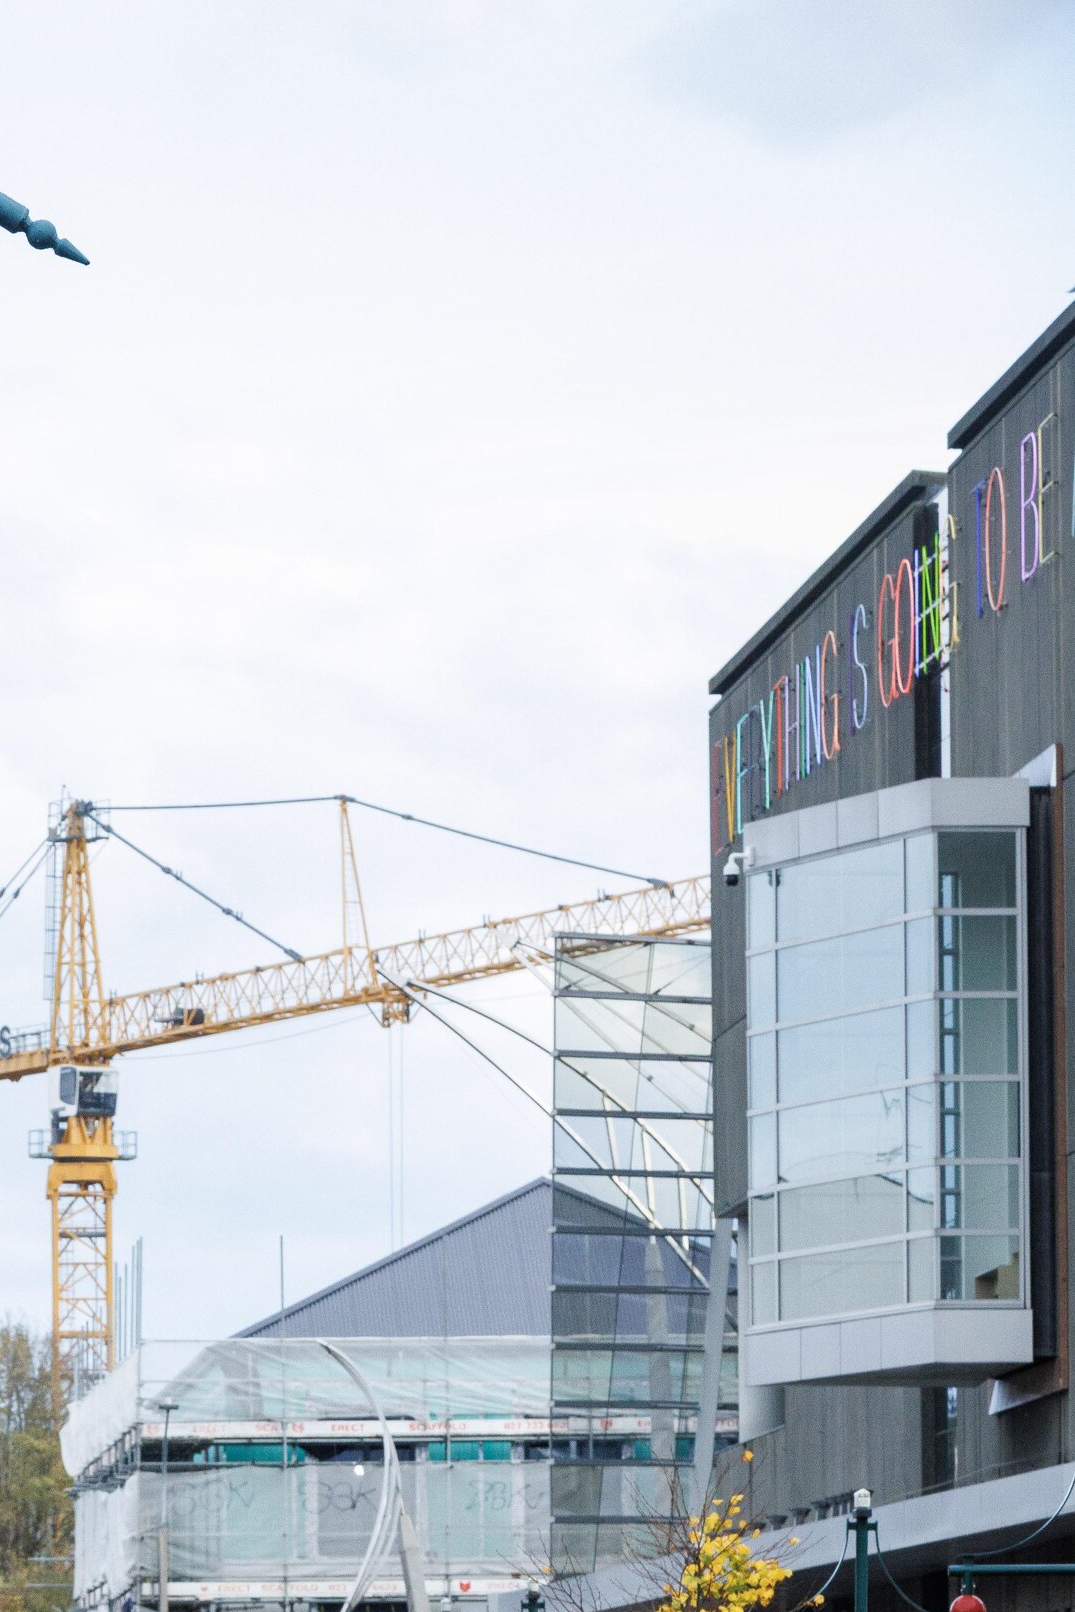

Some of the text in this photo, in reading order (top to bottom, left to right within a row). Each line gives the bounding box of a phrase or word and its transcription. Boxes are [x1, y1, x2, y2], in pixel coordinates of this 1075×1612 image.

[713, 630, 841, 857] EVERYTHING
[877, 514, 961, 708] GOING
[970, 466, 1006, 619] TO
[1021, 412, 1057, 581] BE
